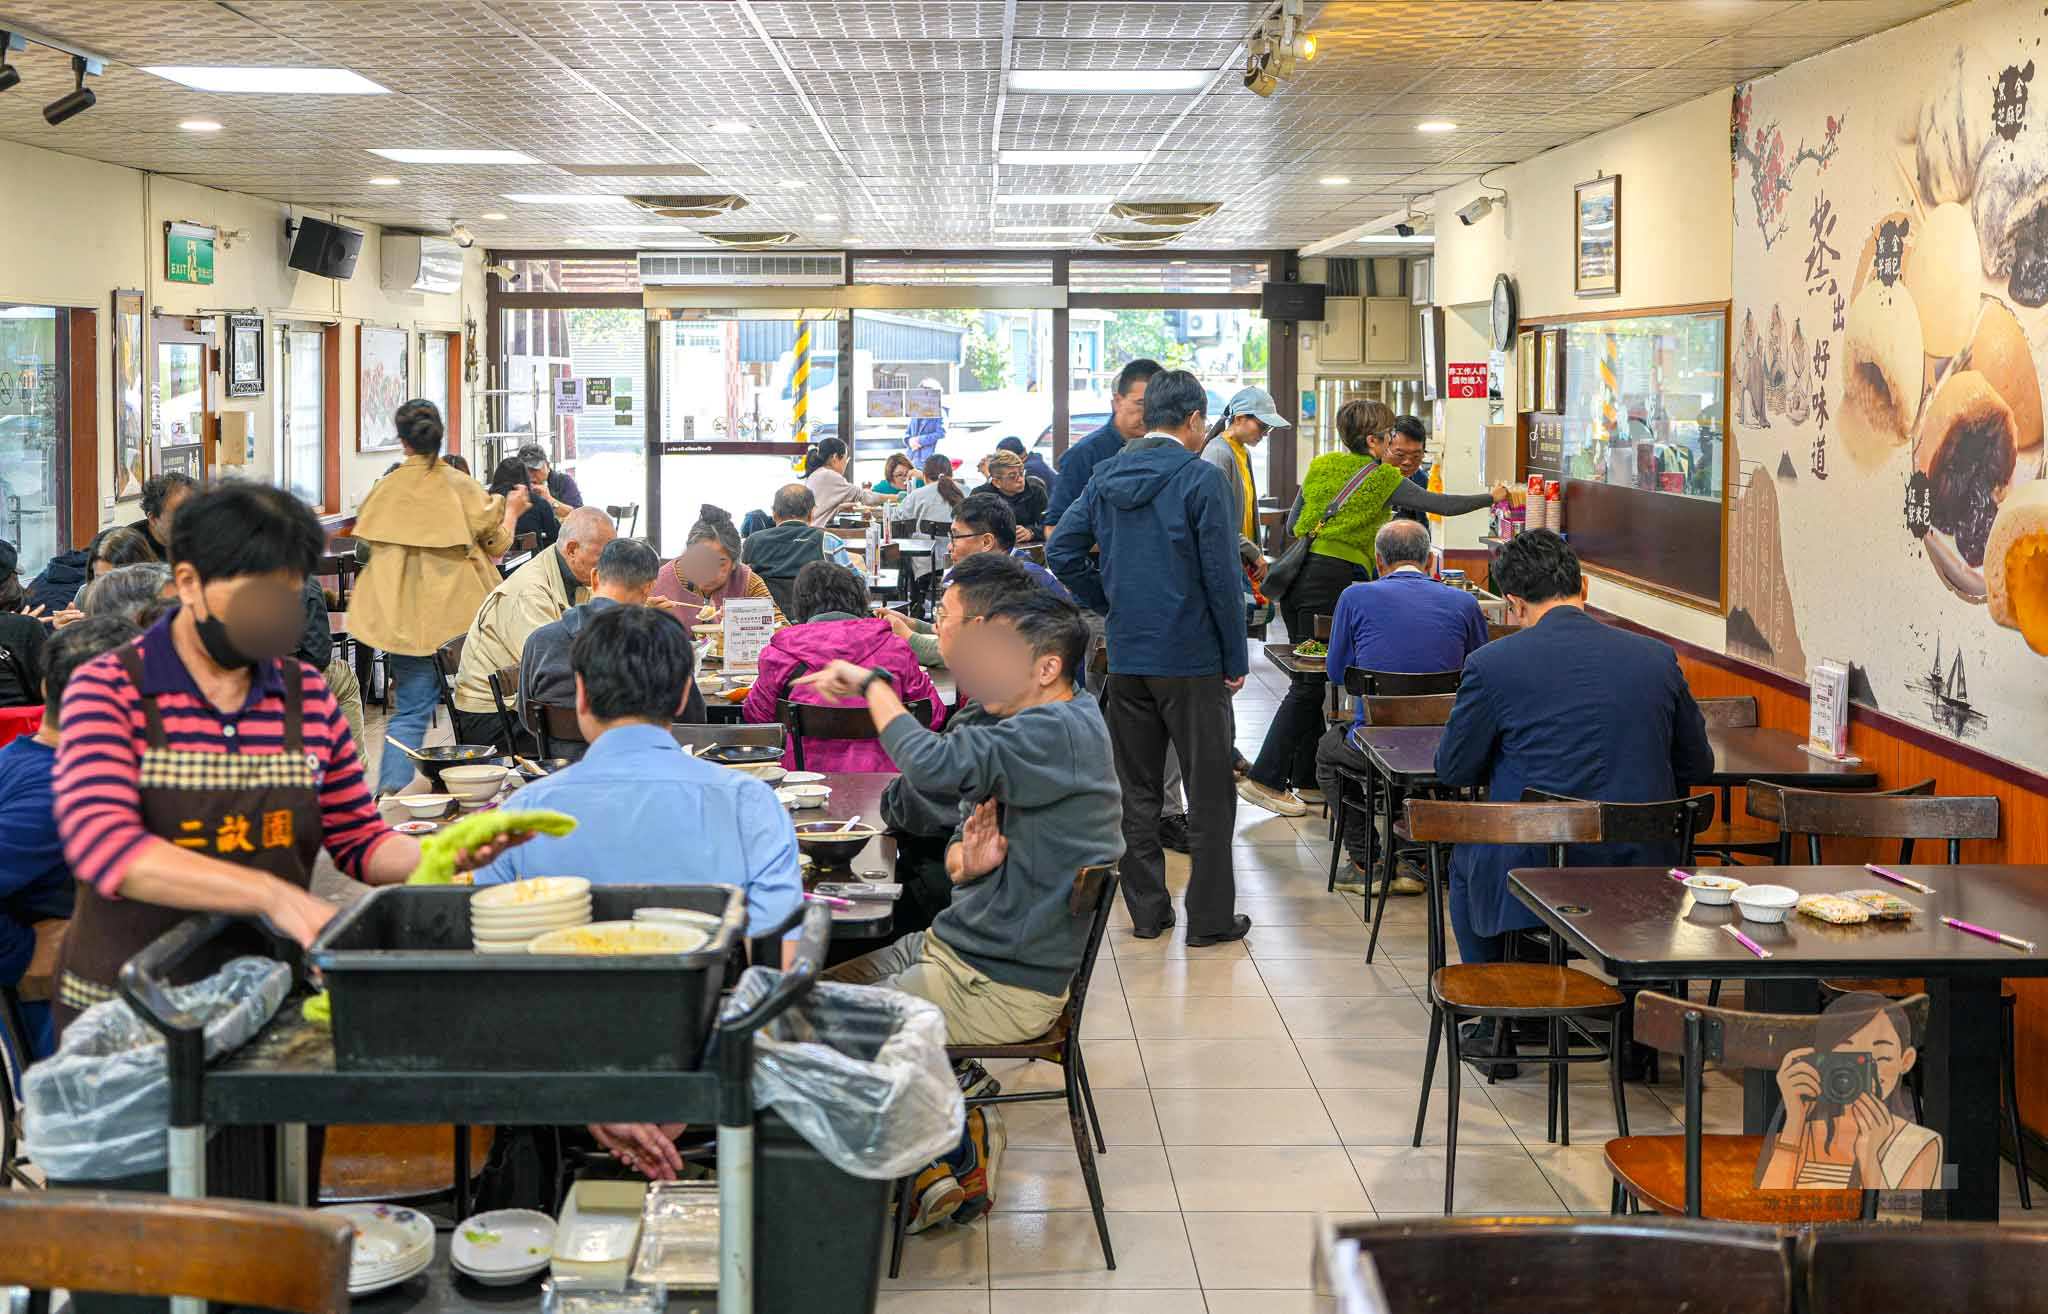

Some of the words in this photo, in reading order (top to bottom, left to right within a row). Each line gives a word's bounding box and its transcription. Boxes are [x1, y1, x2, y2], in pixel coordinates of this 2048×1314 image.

[171, 263, 187, 275] EXIT
[1448, 367, 1487, 375] 非工作人員
